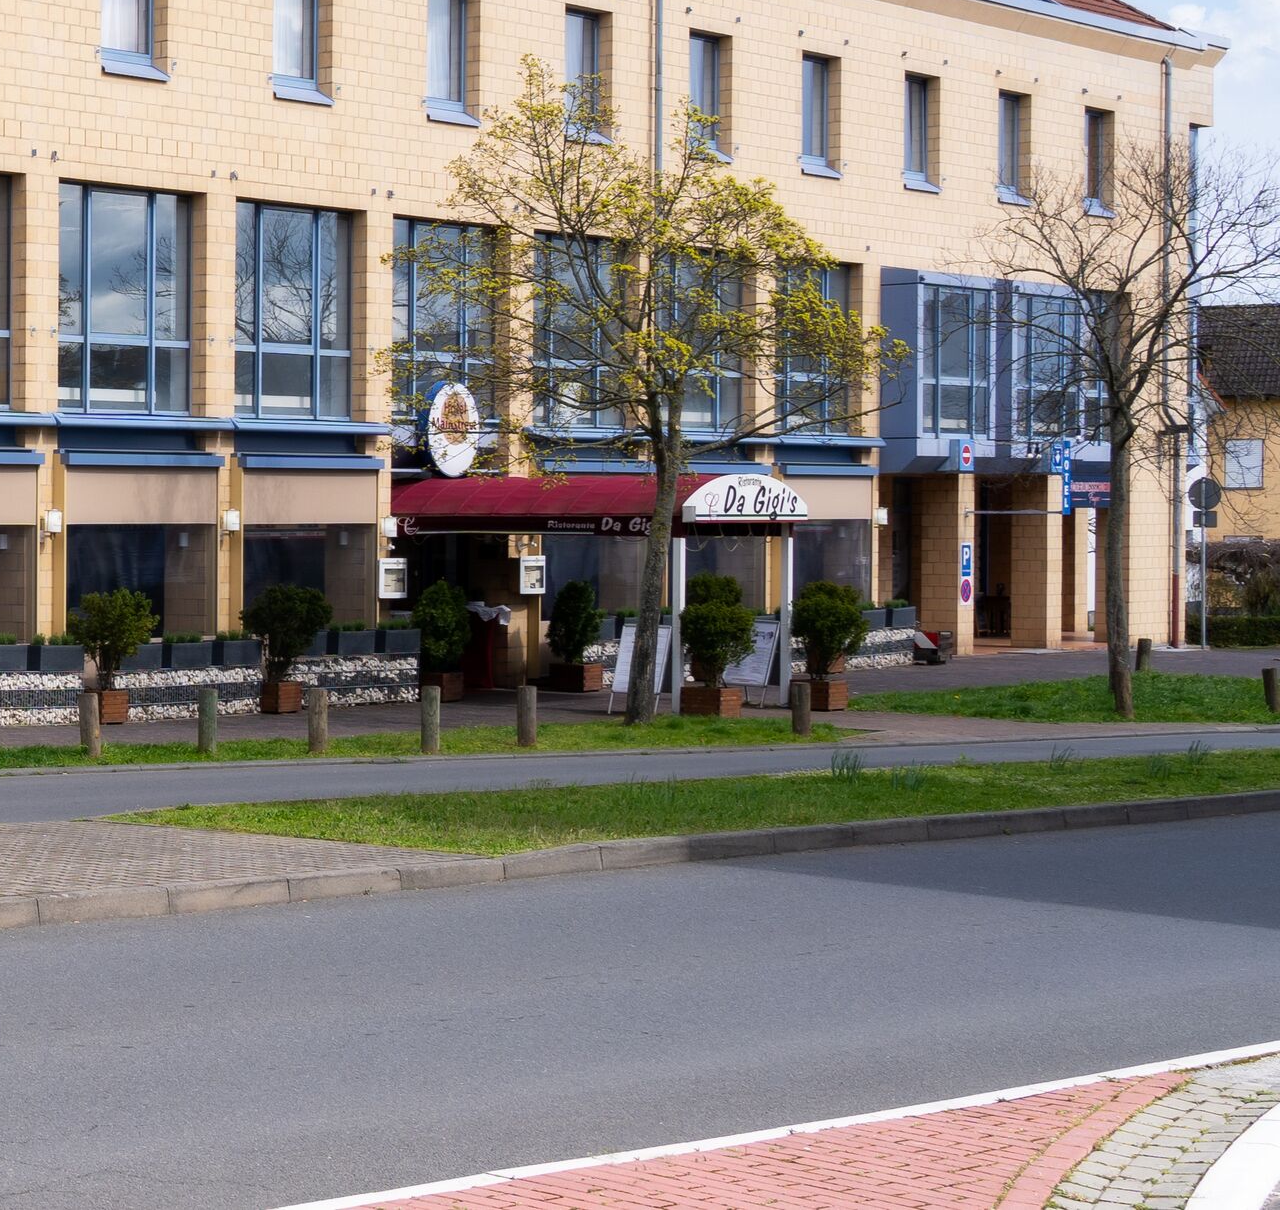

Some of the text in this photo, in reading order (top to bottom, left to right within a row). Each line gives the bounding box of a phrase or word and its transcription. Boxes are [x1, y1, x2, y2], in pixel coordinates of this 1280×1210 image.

[724, 484, 798, 520] Da Gigi's
[547, 520, 595, 530] Ristorante
[601, 516, 622, 532] Da
[963, 547, 970, 566] P
